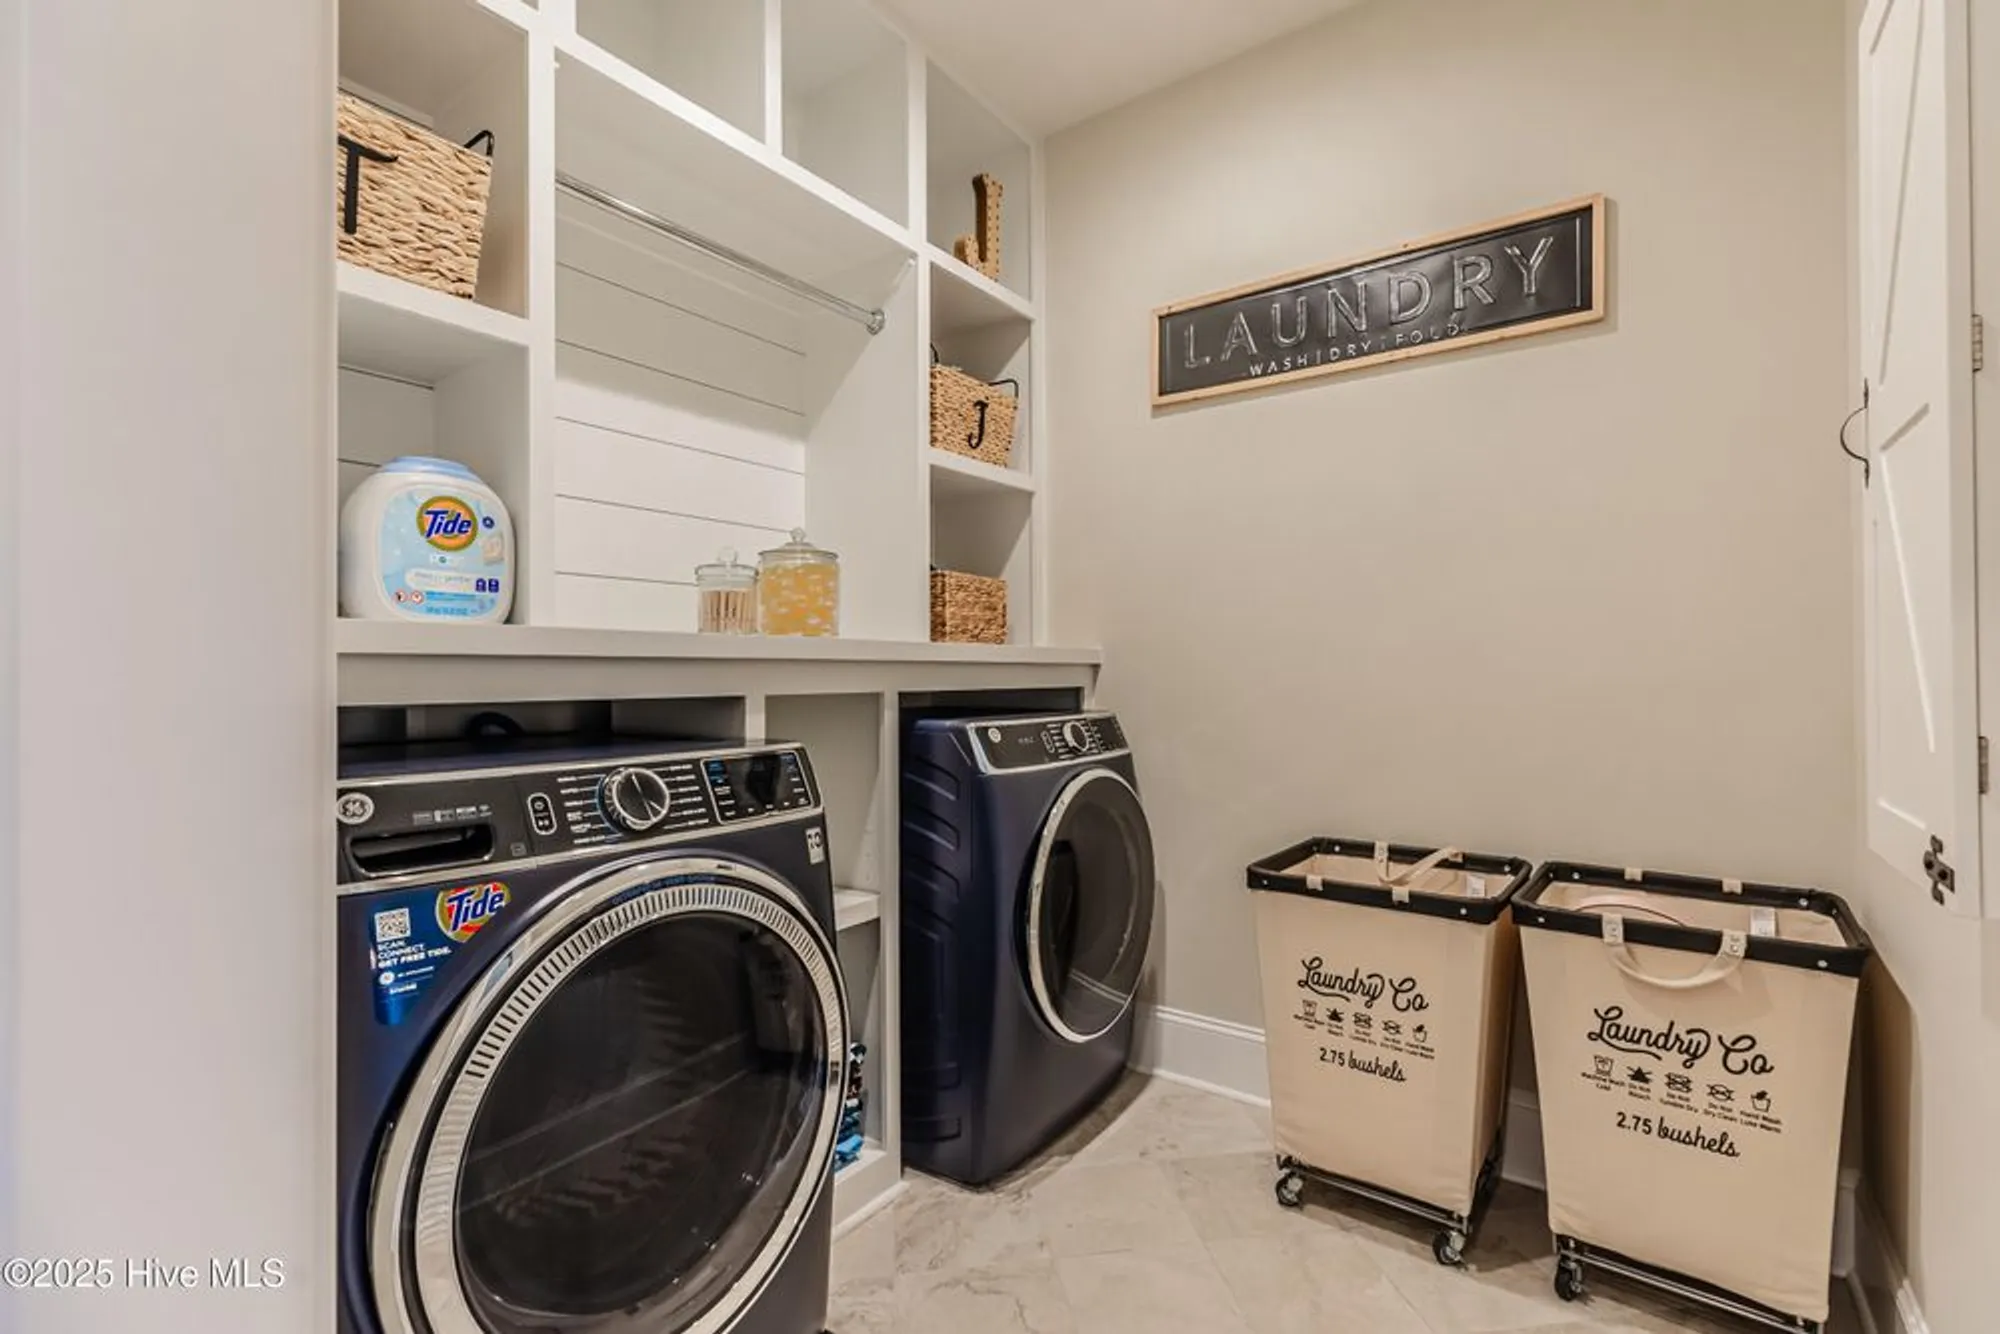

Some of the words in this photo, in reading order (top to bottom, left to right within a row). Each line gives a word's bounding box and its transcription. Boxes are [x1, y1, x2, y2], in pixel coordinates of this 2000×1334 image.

[1184, 236, 1554, 369] LAUNDRY
[1250, 355, 1308, 377] WASH
[1329, 340, 1371, 362] DRY
[1395, 323, 1461, 348] FOLD
[968, 400, 989, 450] J
[425, 508, 473, 539] Tide
[446, 885, 506, 932] Tide
[1297, 956, 1386, 1009] Laundry
[1388, 977, 1430, 1012] Co
[1319, 1046, 1346, 1067] 2.75
[1347, 1049, 1407, 1083] bushels
[1587, 1006, 1711, 1069] Laundry
[1717, 1034, 1775, 1075] Co
[1616, 1111, 1654, 1136] 2.75
[1657, 1117, 1741, 1158] bushels
